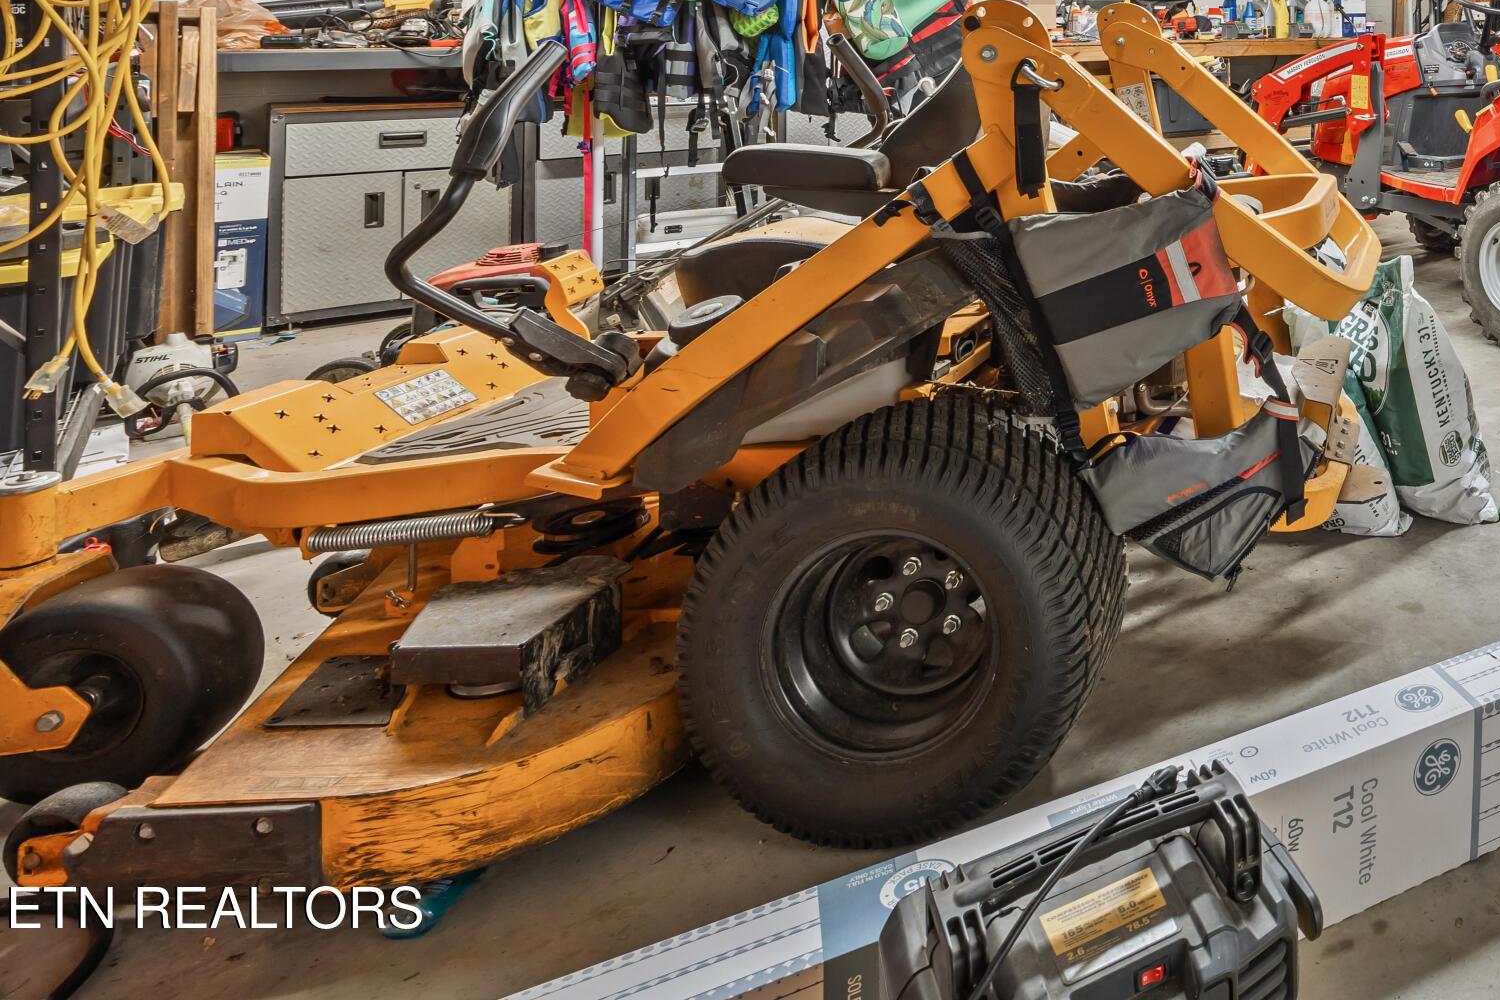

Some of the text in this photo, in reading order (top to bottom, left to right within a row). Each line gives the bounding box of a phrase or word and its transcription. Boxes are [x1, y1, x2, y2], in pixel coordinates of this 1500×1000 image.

[1286, 53, 1326, 75] MASSEY FERGUSON
[1386, 48, 1411, 58] ERGUSON
[135, 354, 170, 364] STIHL
[1417, 325, 1451, 429] KENTUCKY 31
[1342, 703, 1381, 724] T12
[1303, 716, 1390, 754] Cool White
[1250, 768, 1278, 784] 60w
[1069, 792, 1117, 815] White Light
[1332, 785, 1355, 834] T12
[1288, 817, 1304, 851] 60w
[1358, 777, 1379, 886] Cool White
[903, 875, 929, 894] 15
[1062, 926, 1083, 940] 165
[847, 974, 862, 1000] SOL
